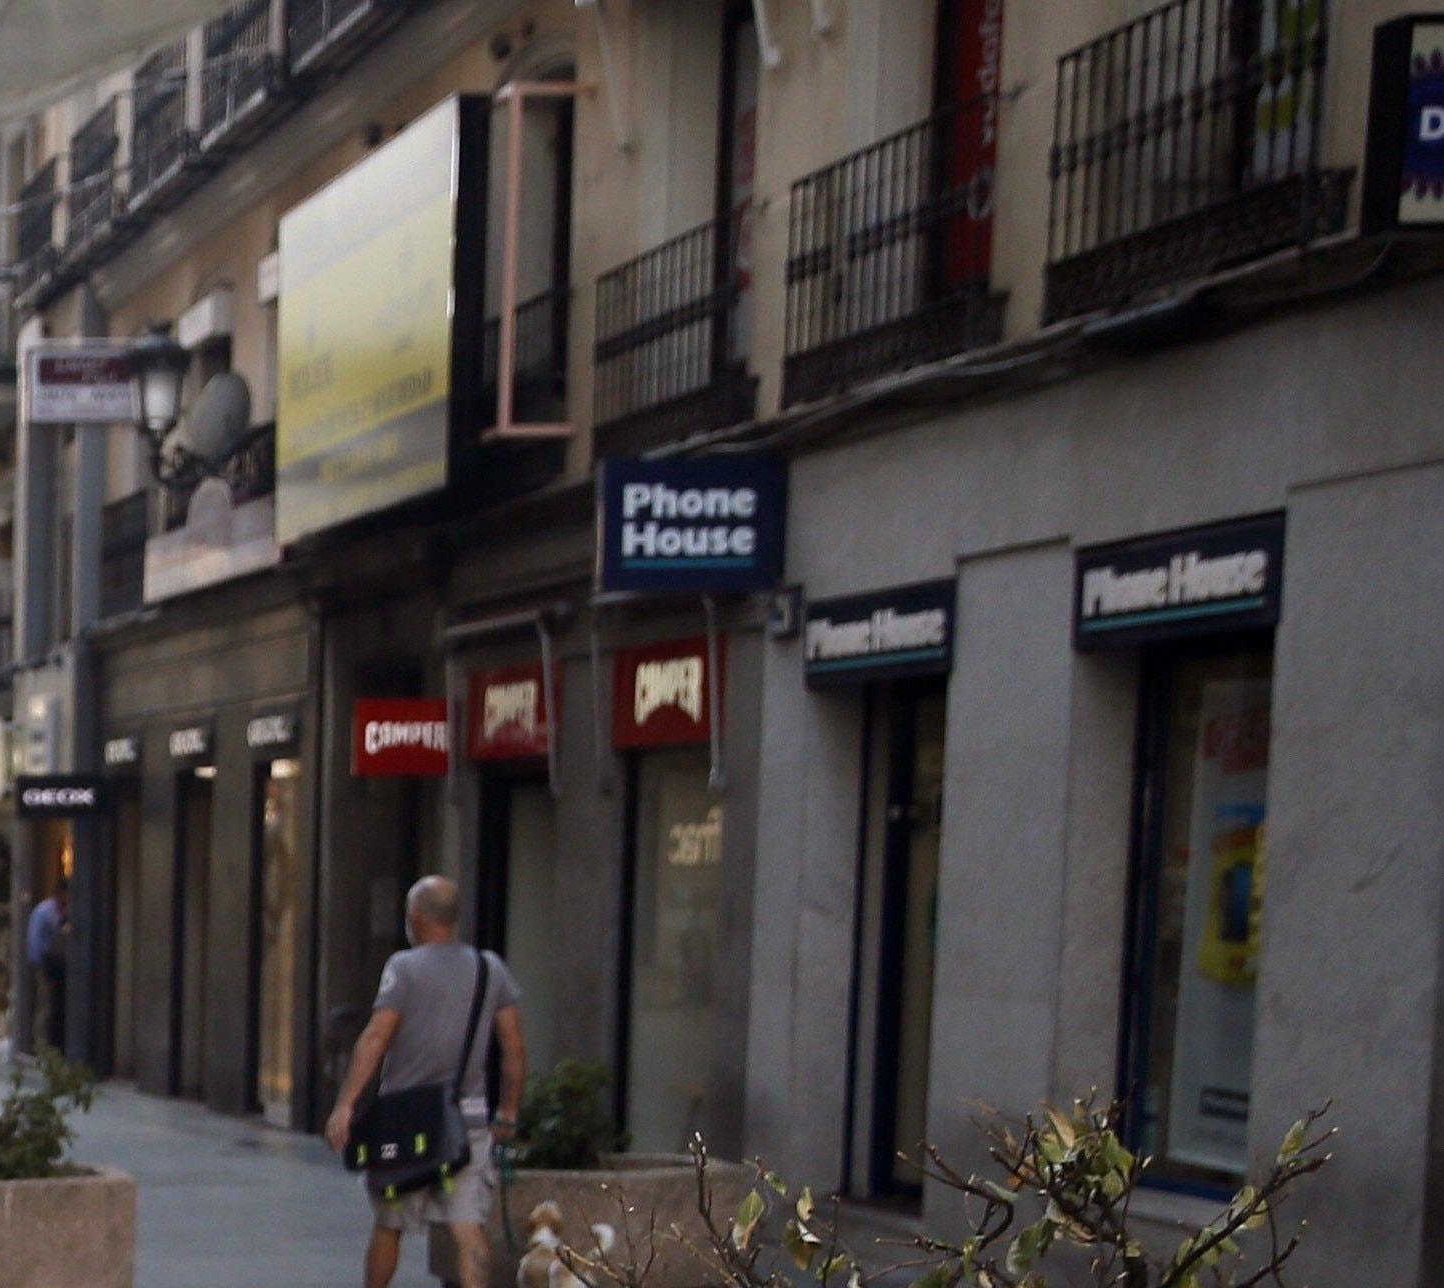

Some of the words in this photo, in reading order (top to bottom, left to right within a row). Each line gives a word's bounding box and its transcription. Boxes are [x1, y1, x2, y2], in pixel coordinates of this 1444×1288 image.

[622, 482, 757, 518] Phone
[622, 523, 756, 557] House
[1168, 548, 1267, 606] House
